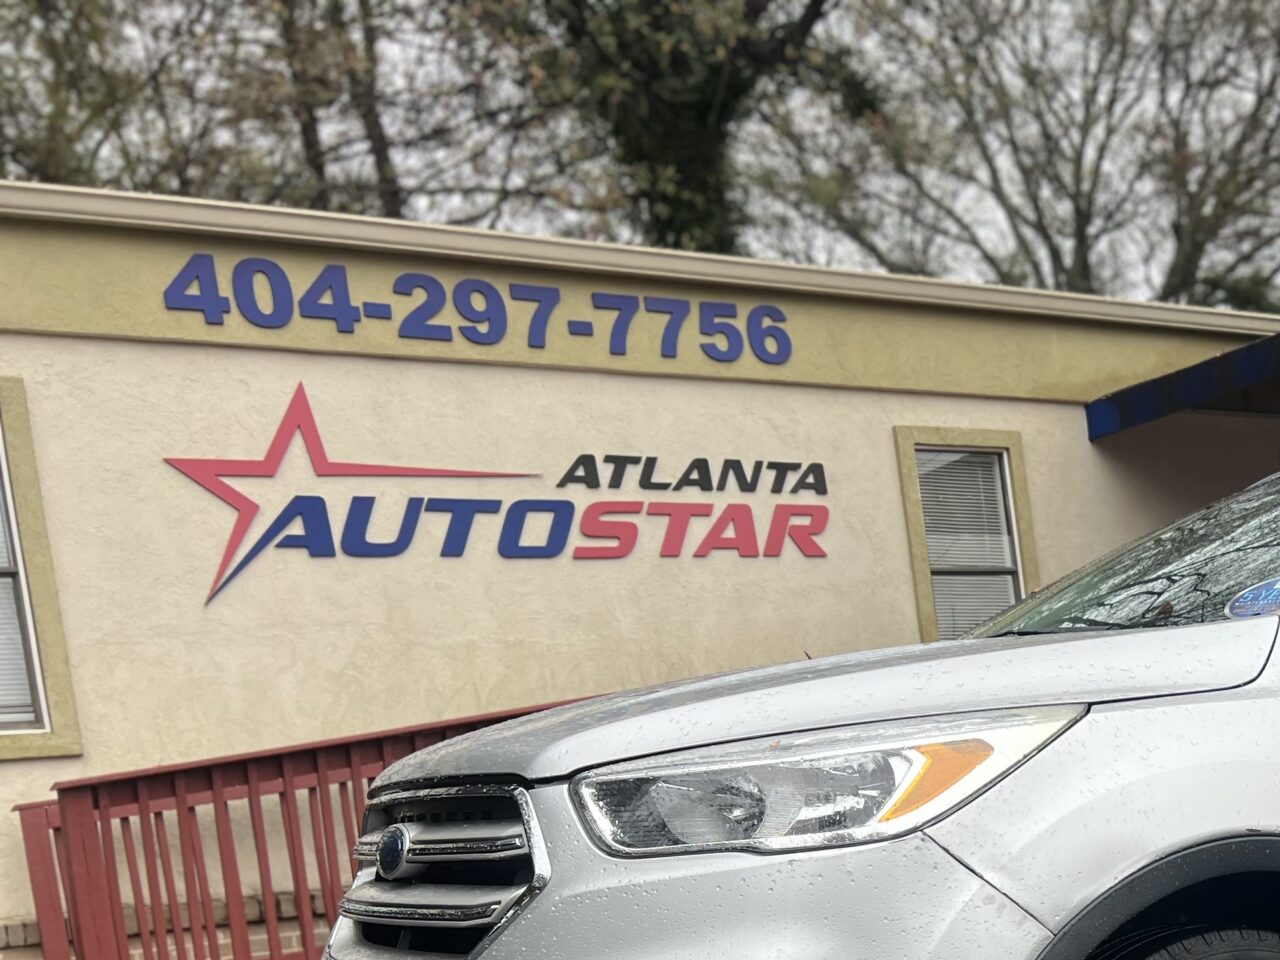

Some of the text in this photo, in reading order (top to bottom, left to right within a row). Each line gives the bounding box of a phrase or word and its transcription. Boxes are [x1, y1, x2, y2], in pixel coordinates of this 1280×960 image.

[163, 253, 792, 365] 404-297-7756
[555, 454, 828, 495] ATLANTA
[1239, 591, 1254, 602] 5
